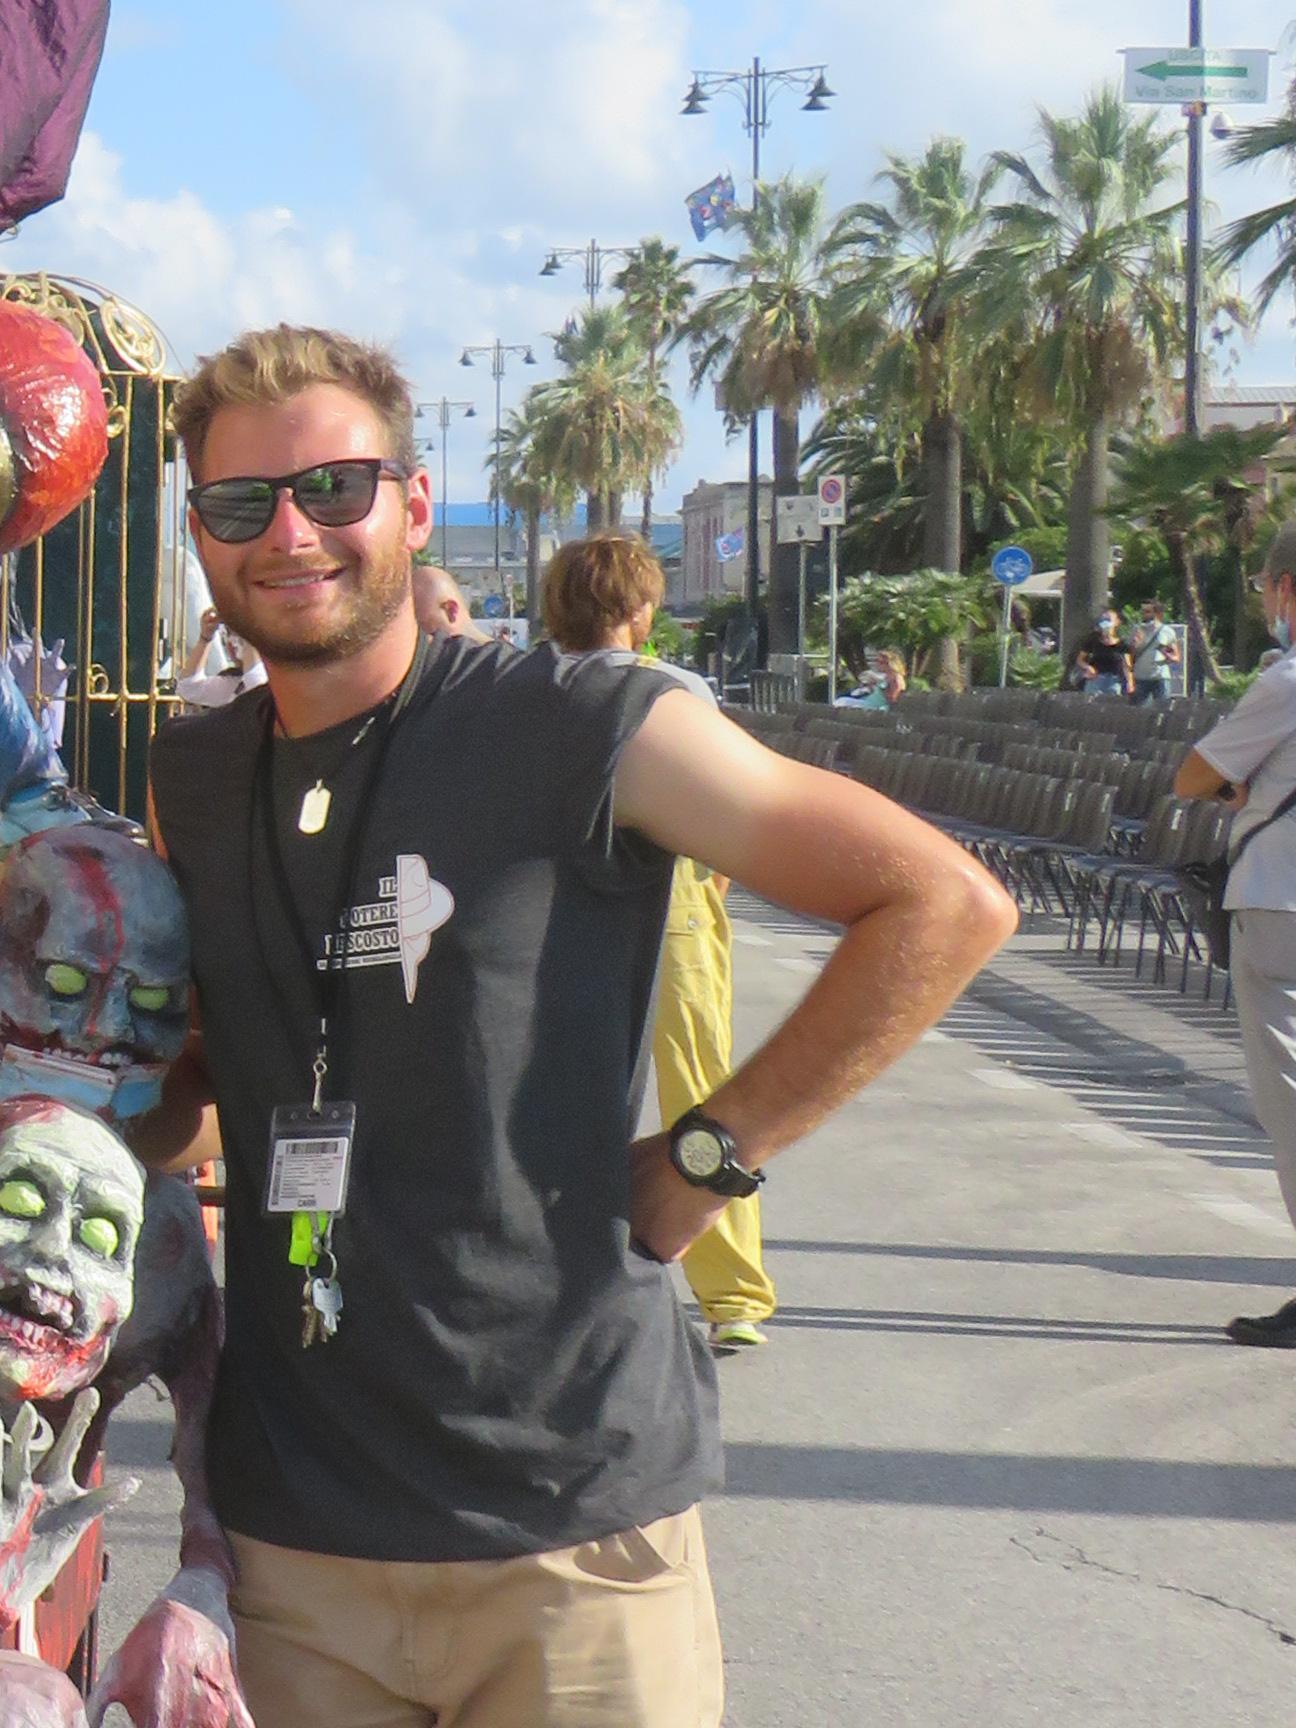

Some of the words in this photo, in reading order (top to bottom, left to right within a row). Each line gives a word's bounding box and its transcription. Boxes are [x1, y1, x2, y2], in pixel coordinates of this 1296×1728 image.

[379, 876, 398, 897] IL
[340, 901, 399, 928] OTERE
[325, 927, 400, 955] SCOSTO
